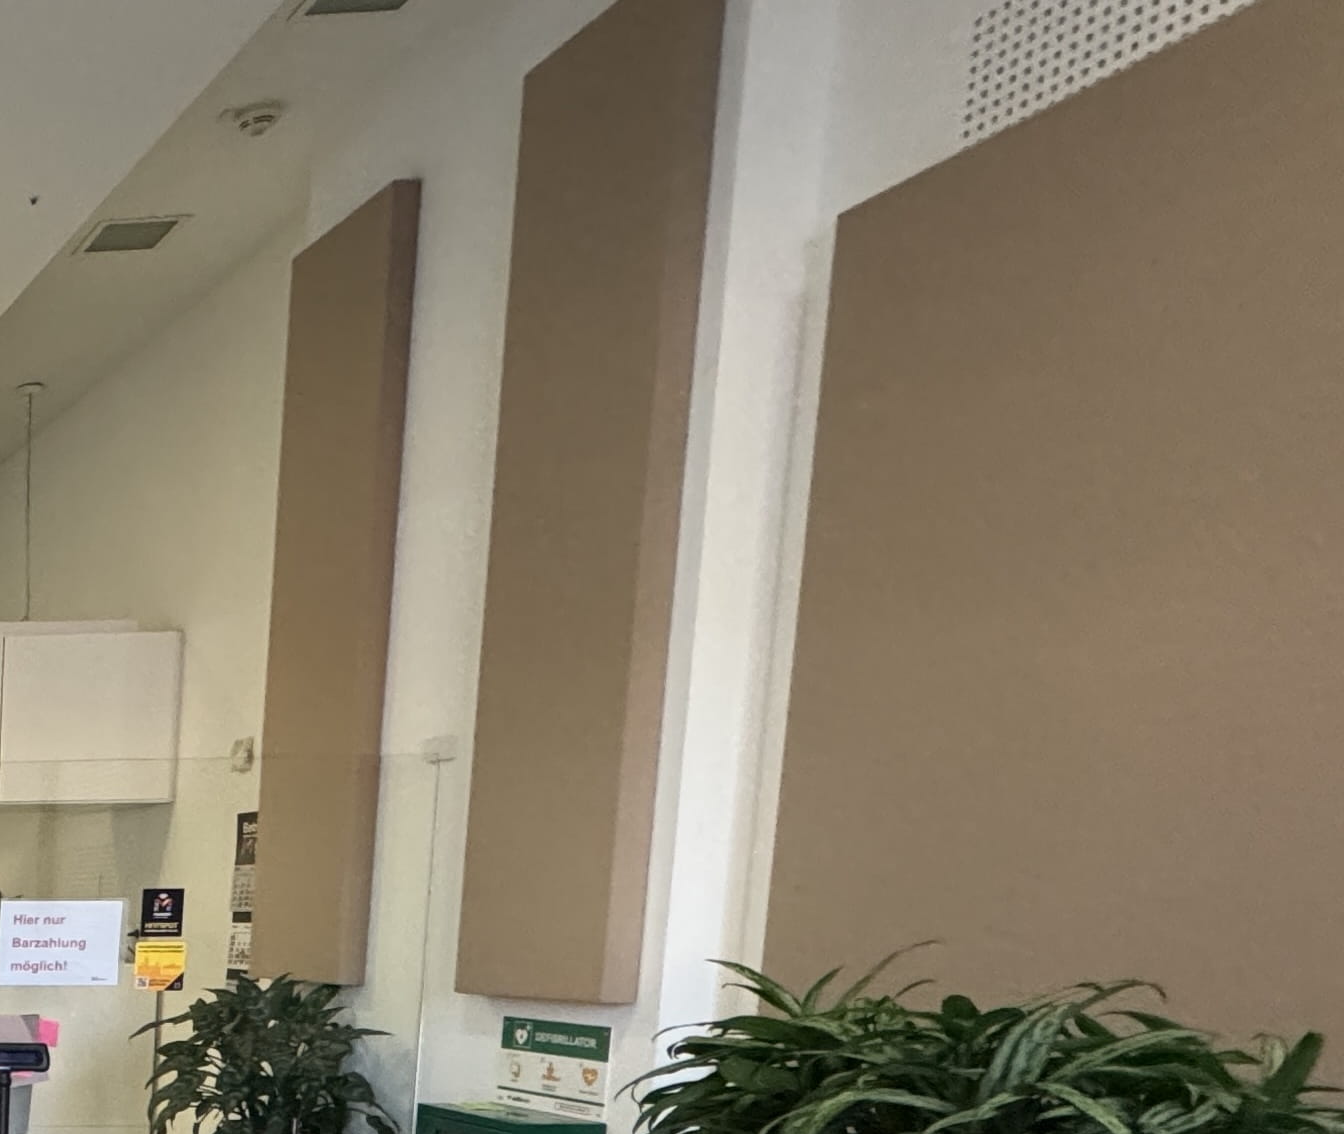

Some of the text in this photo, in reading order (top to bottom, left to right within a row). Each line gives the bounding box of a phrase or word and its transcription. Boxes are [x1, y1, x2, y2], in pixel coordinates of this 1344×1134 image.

[13, 914, 66, 925] Hier nur
[12, 938, 86, 951] Barzahlung
[10, 961, 67, 974] möglich!
